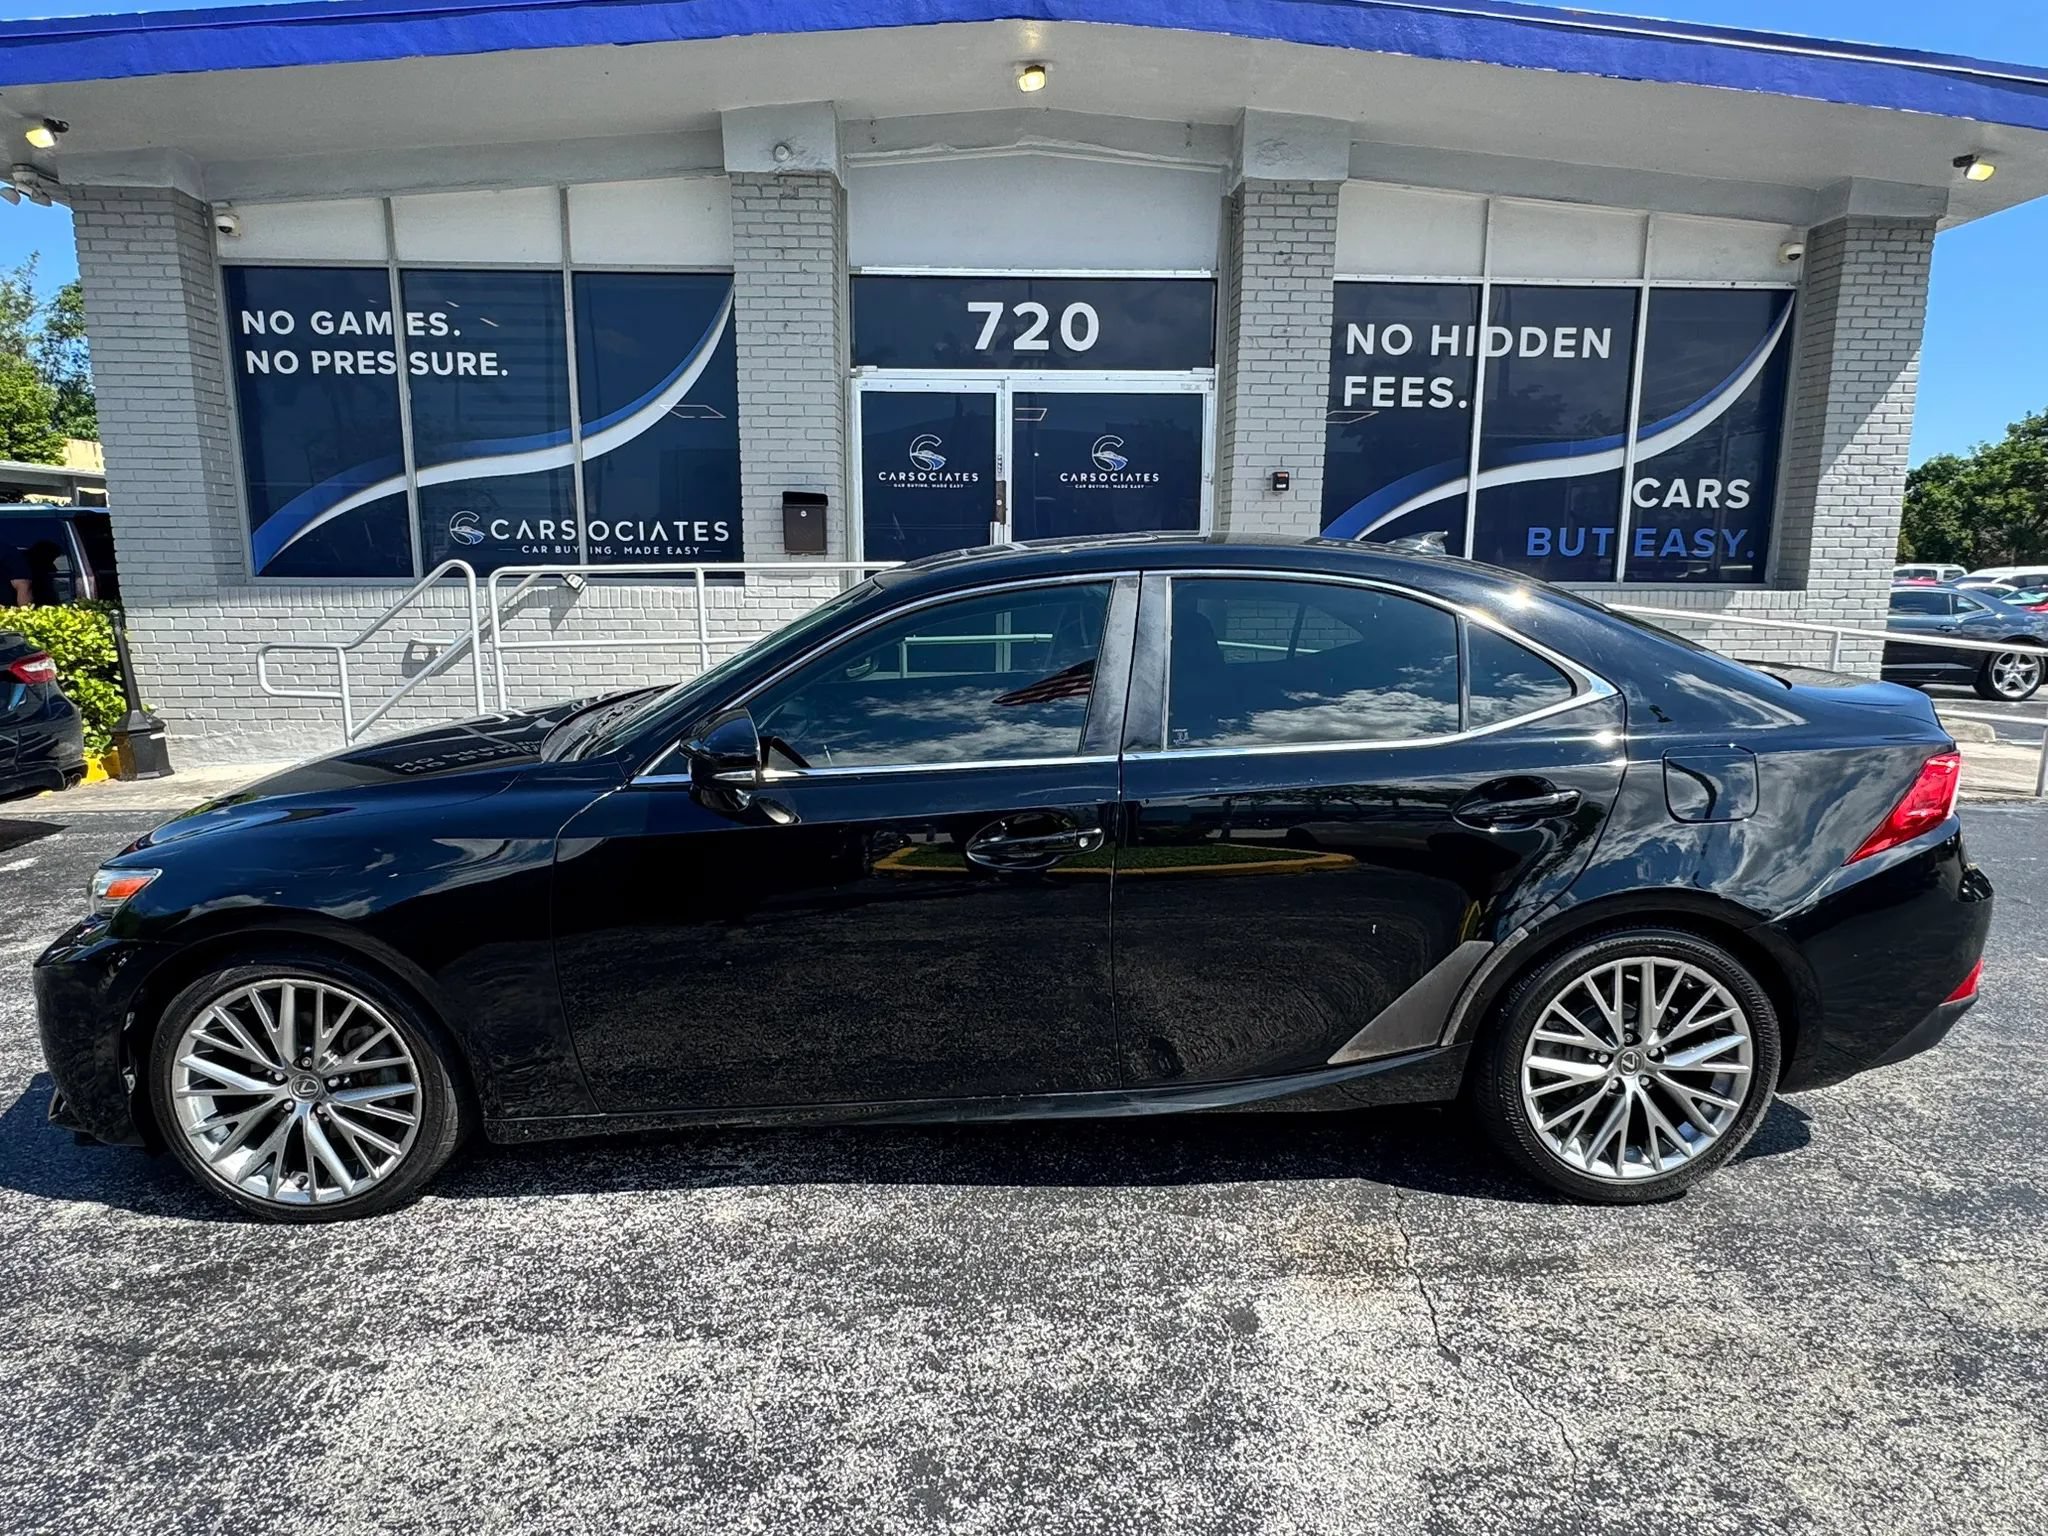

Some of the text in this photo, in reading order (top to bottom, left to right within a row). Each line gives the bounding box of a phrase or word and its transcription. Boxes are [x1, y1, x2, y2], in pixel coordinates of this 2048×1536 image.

[241, 310, 461, 337] NO GAMES.
[967, 301, 1100, 352] 720
[1345, 322, 1612, 359] NO HIDDEN
[246, 350, 508, 377] NO PRESSURE.
[1343, 375, 1467, 409] FEES.
[878, 472, 979, 482] CARSOCIATES
[1059, 472, 1160, 483] CARSOCIATES
[1632, 477, 1751, 509] CARS
[490, 519, 729, 542] CARSOCIATES
[1526, 527, 1755, 558] BUT EASY.
[521, 545, 548, 554] CAR
[624, 546, 660, 555] MADE
[667, 546, 699, 555] EASY
